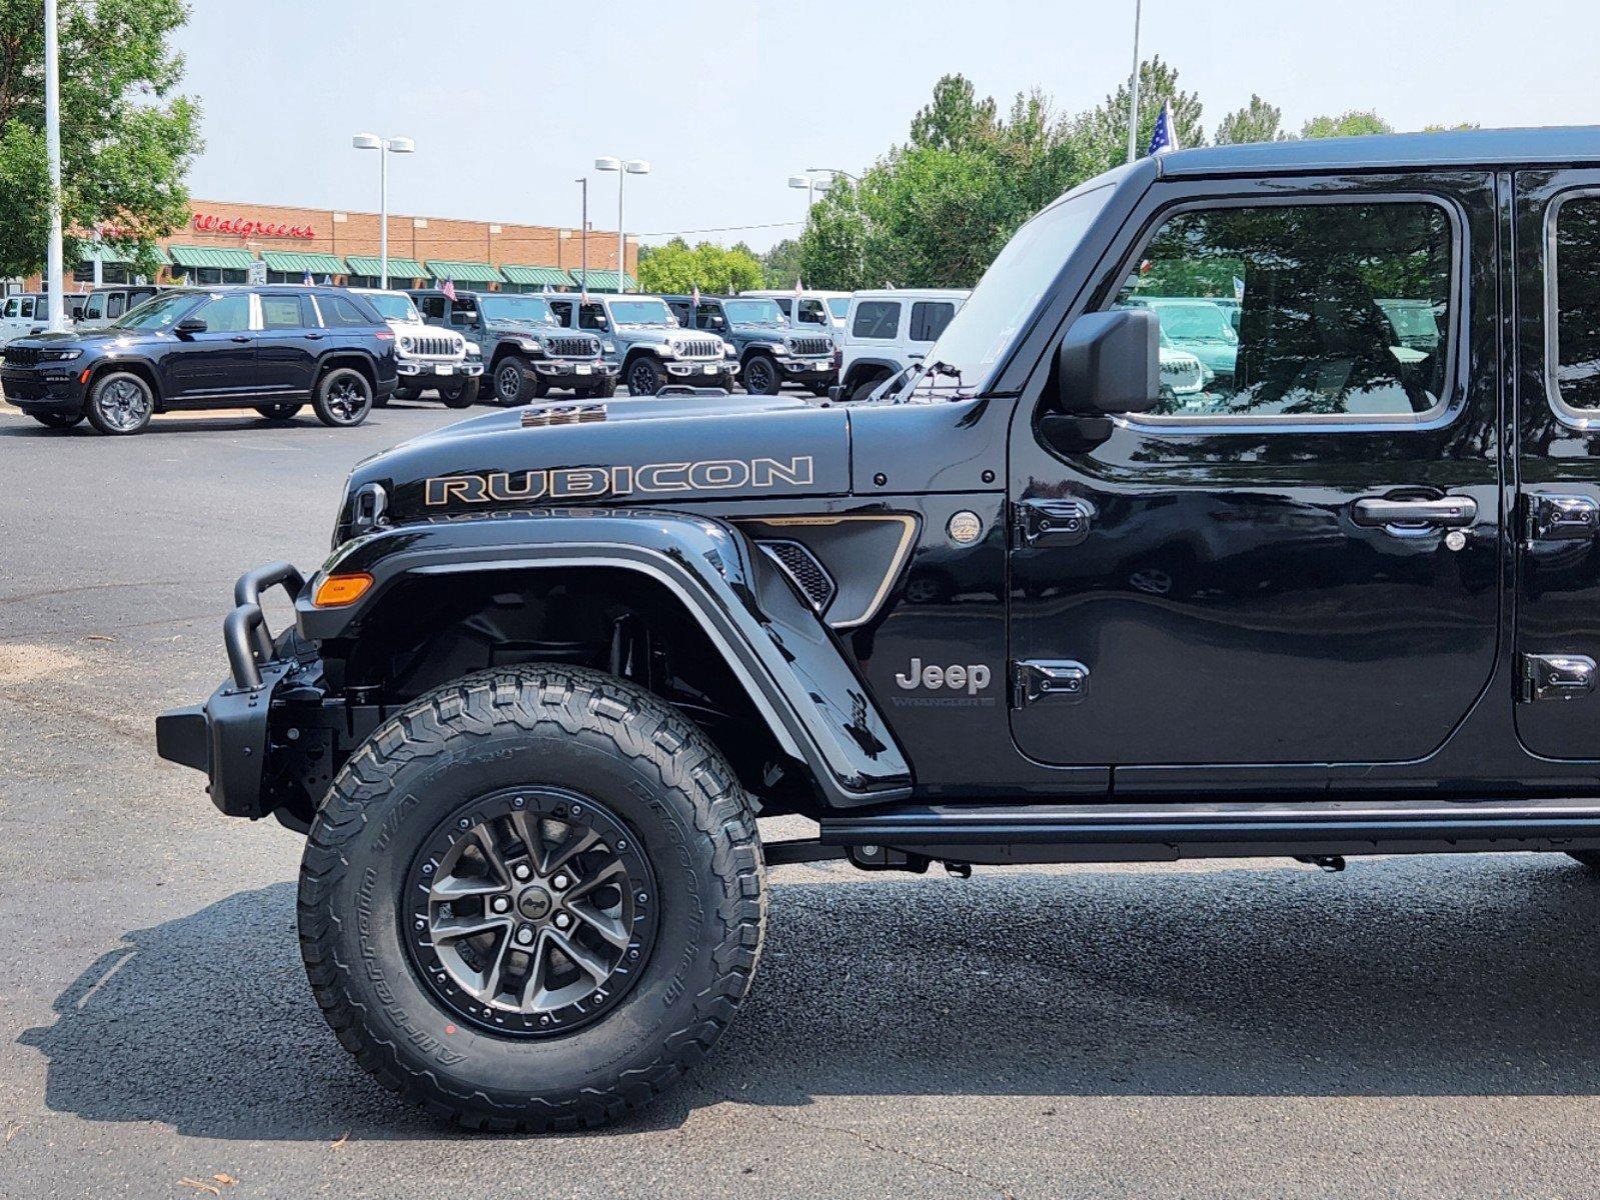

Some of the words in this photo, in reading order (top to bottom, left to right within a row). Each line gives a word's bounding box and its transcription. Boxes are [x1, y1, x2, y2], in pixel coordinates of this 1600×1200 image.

[193, 214, 315, 239] Walgreens
[425, 456, 814, 505] RUBICON
[895, 658, 991, 695] Jeep
